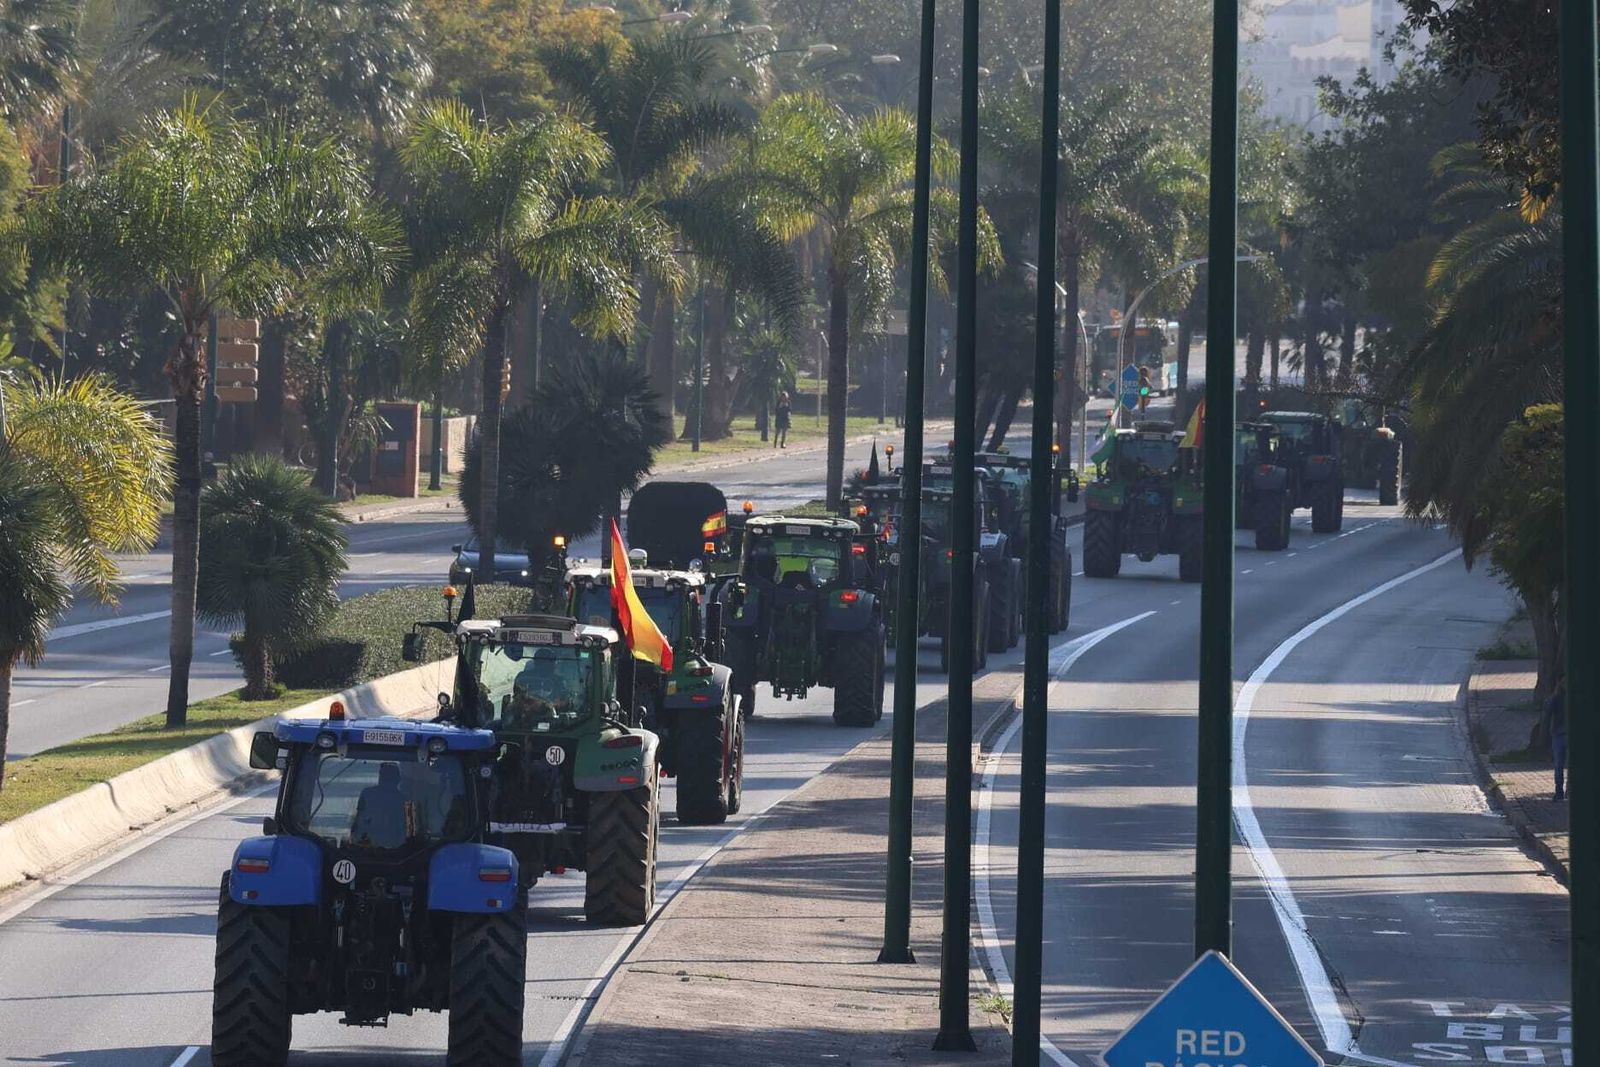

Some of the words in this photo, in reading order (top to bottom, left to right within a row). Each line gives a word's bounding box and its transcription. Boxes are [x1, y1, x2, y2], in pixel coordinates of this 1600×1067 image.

[549, 747, 560, 764] 50
[336, 861, 350, 880] 40
[1176, 1029, 1246, 1056] RED
